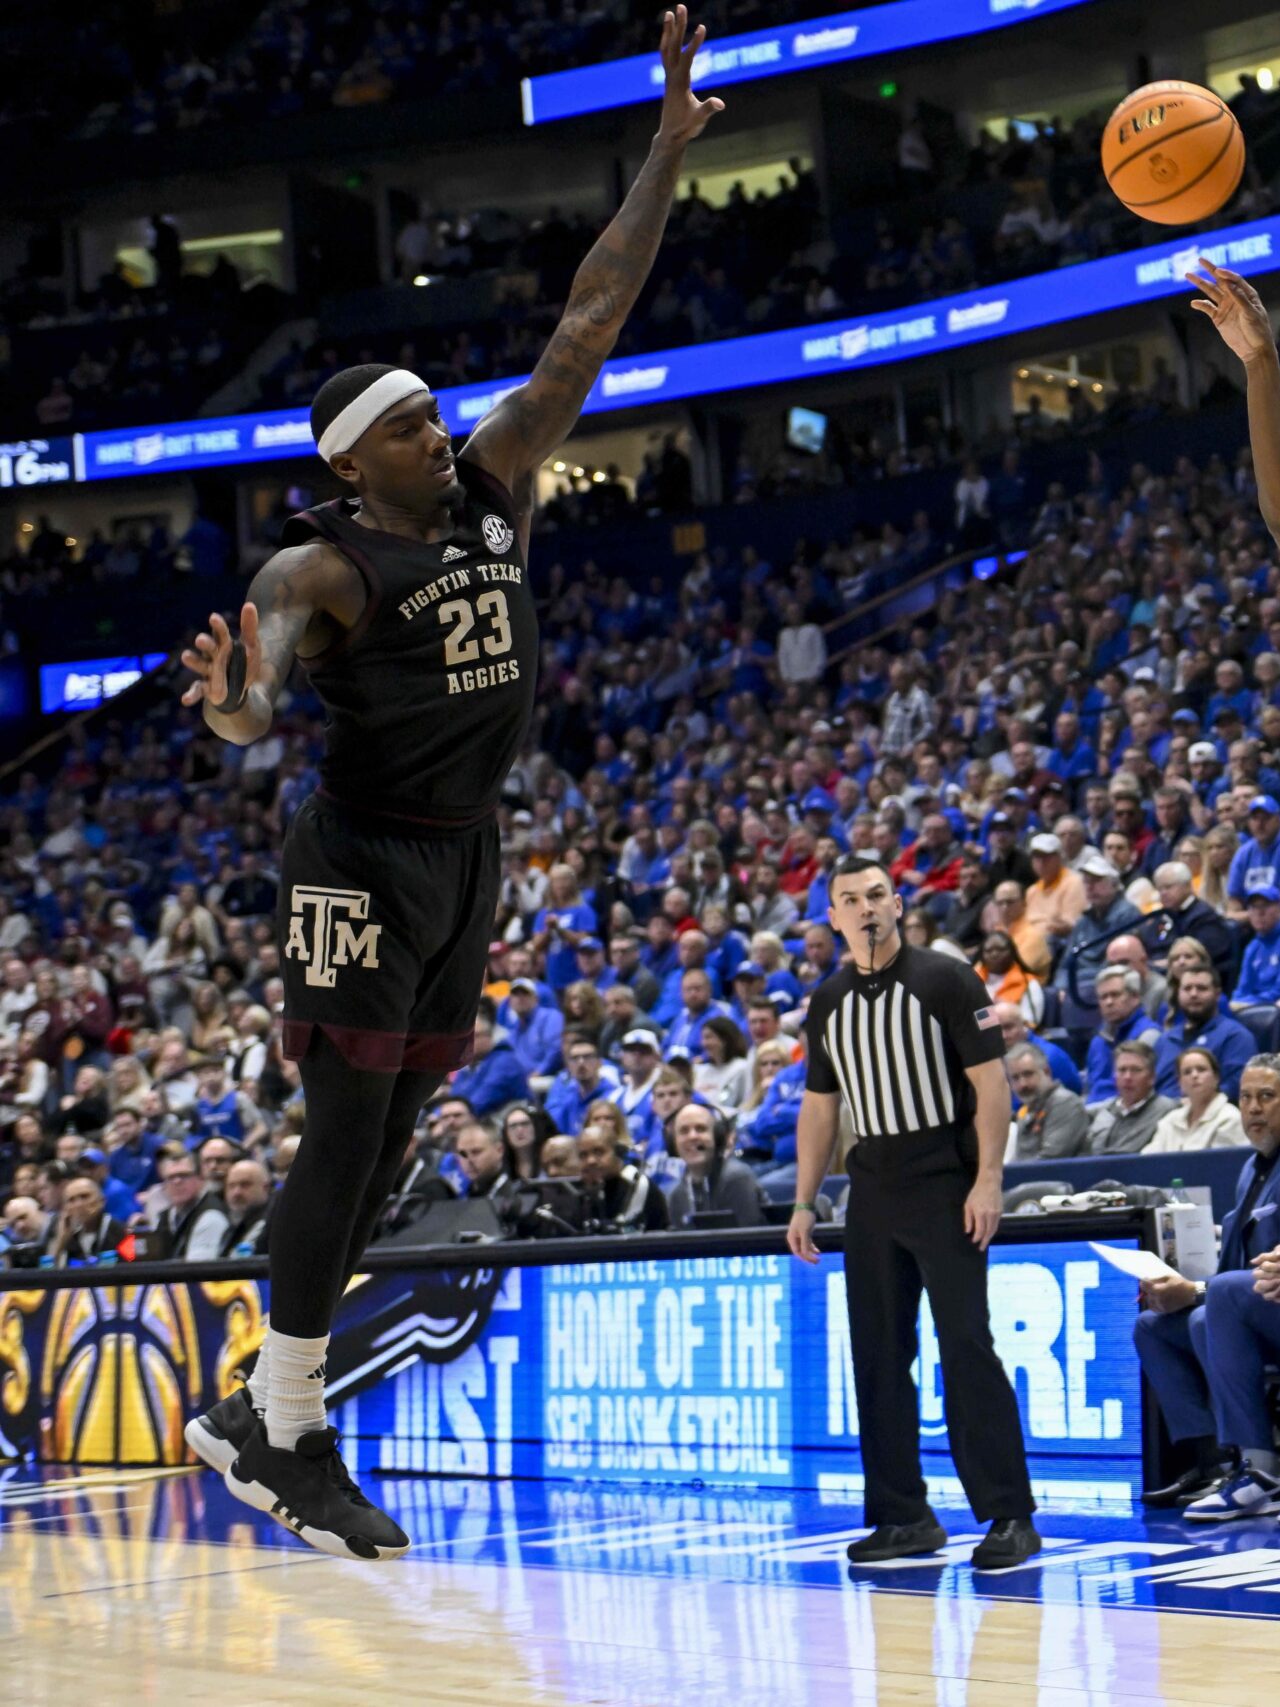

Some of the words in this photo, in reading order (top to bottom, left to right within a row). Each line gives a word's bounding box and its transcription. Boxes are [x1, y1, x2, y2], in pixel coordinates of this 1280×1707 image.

[442, 551, 468, 563] adidas
[398, 569, 471, 621] FIGHTIN'
[477, 564, 522, 584] TEXAS
[438, 589, 513, 666] 23
[447, 659, 520, 694] AGGIES
[549, 1289, 647, 1389] HOME
[654, 1286, 706, 1386] OF
[717, 1284, 784, 1389] THE
[546, 1396, 592, 1468] SEC
[597, 1395, 790, 1475] BASKETBALL
